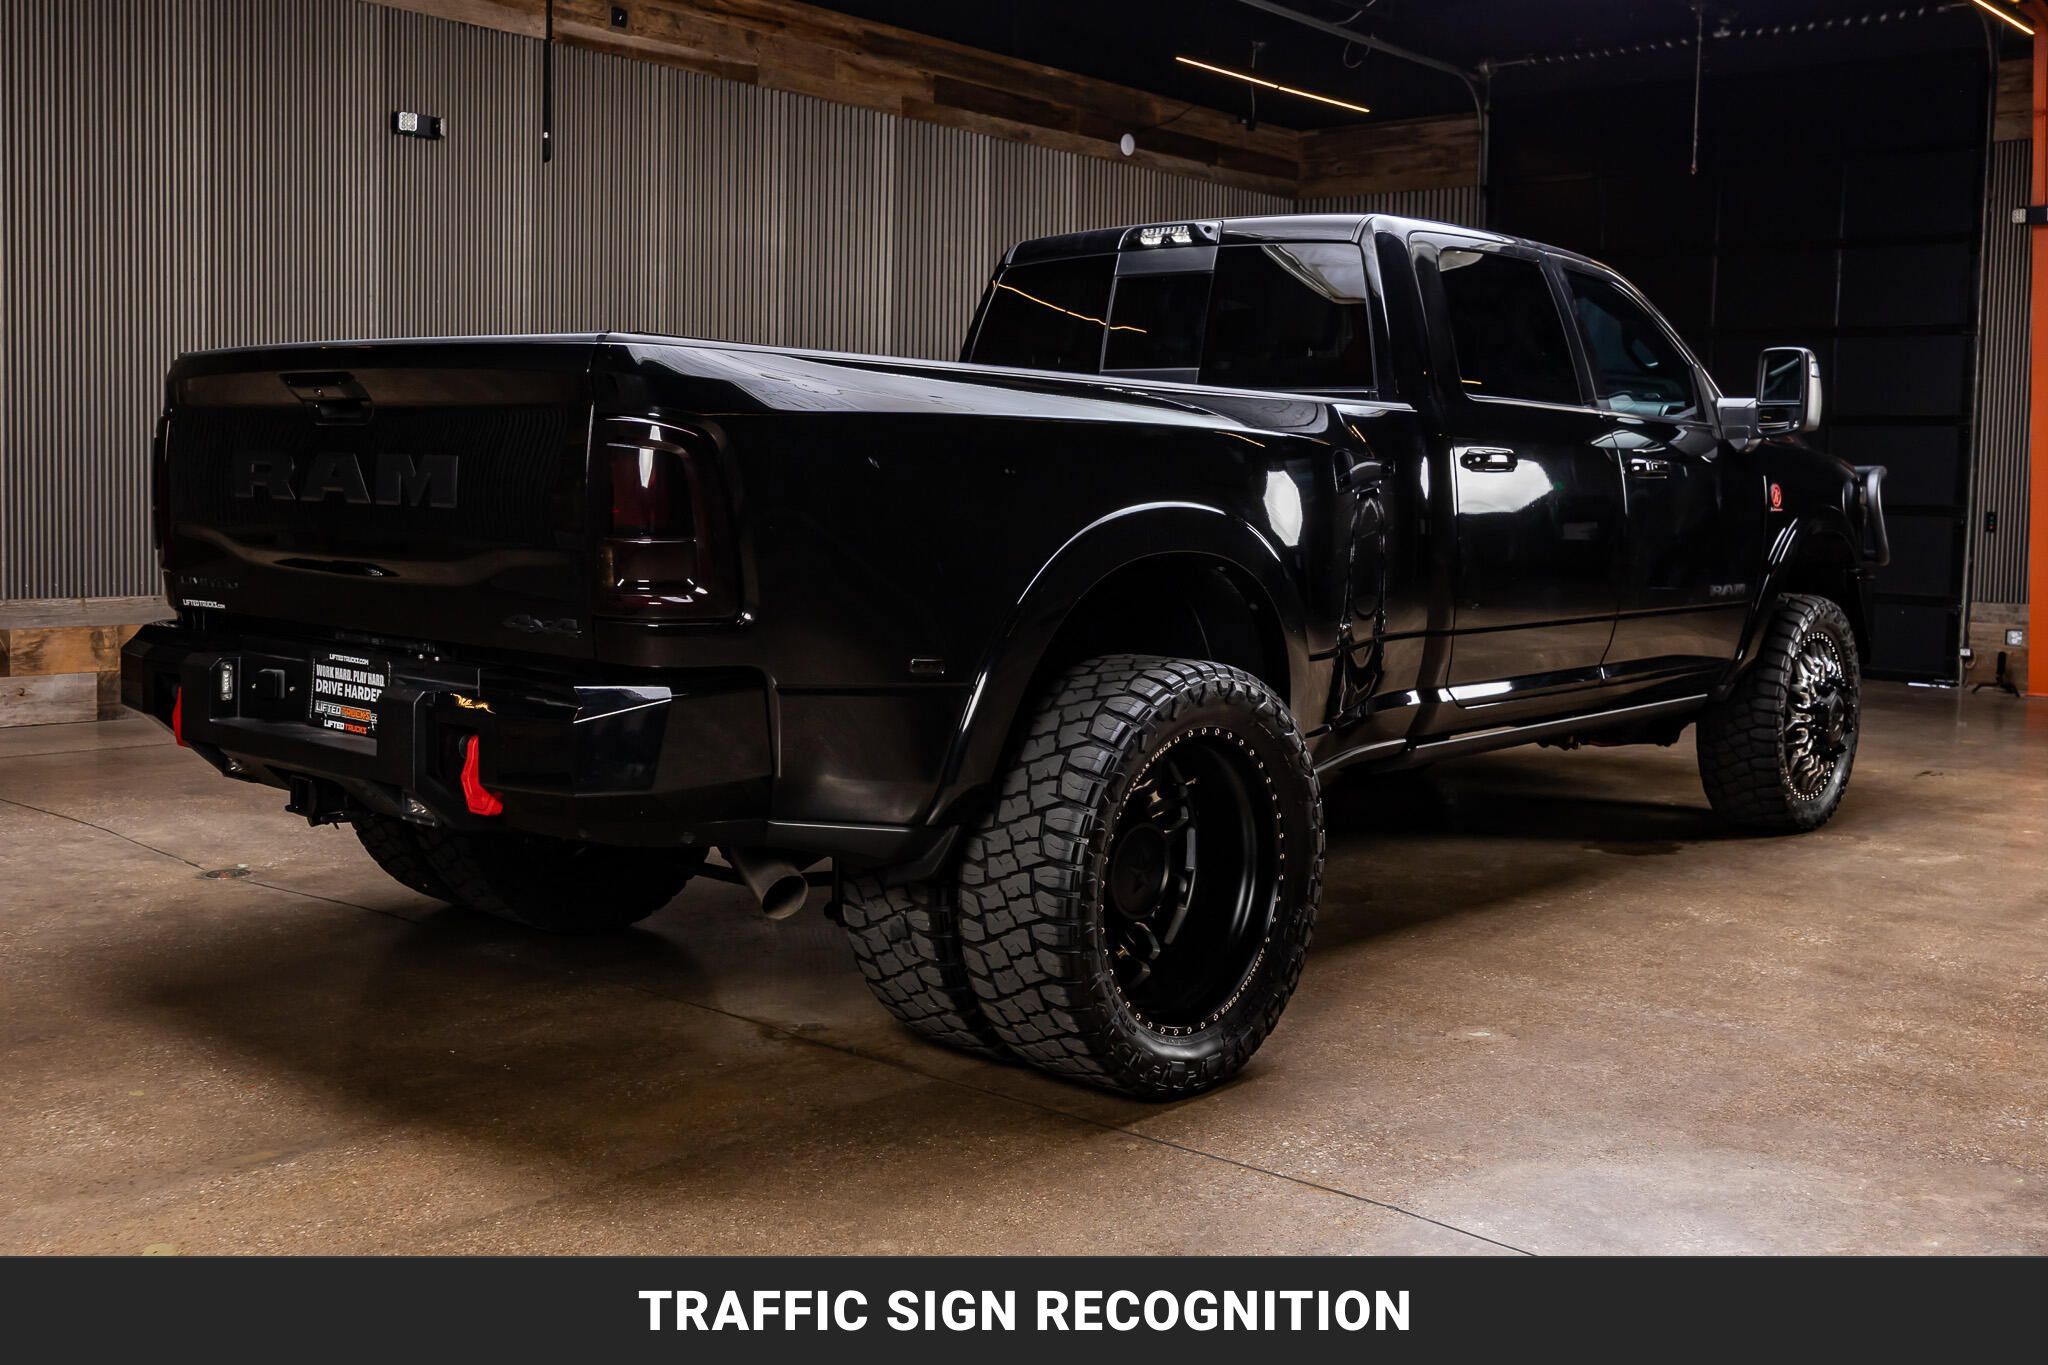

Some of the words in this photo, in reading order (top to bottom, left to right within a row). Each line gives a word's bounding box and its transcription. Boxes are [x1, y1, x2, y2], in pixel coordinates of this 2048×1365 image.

[232, 452, 459, 509] RAM
[1709, 583, 1746, 598] RAM
[316, 664, 335, 679] WORK
[334, 667, 353, 682] HARD.
[353, 670, 367, 684] PLAY
[315, 678, 344, 697] DRIVE
